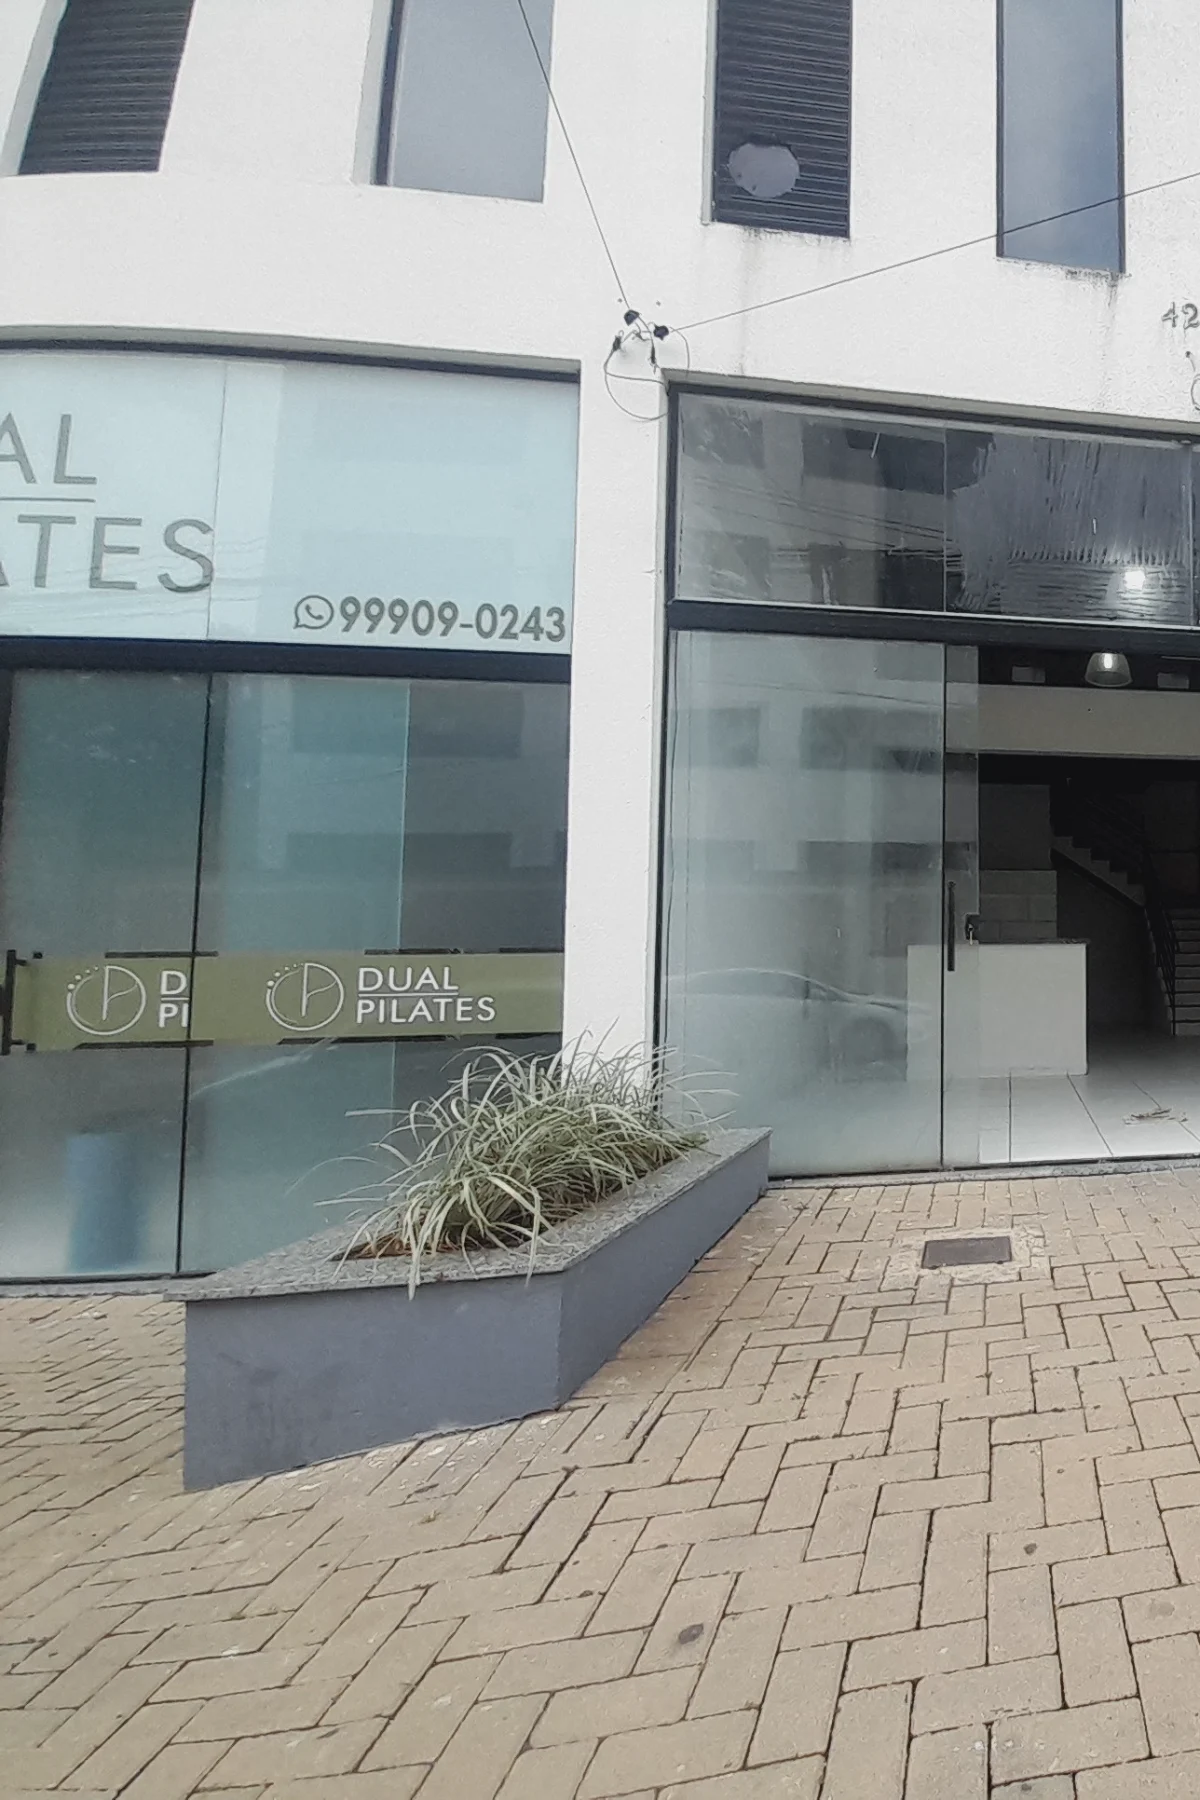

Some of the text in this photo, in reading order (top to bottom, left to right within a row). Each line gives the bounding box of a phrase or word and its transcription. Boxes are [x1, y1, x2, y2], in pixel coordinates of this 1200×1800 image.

[1161, 301, 1200, 330] 42
[0, 514, 214, 593] TES
[340, 596, 566, 642] 99909-0243
[358, 966, 459, 991] DUAL
[356, 997, 496, 1024] PILATES
